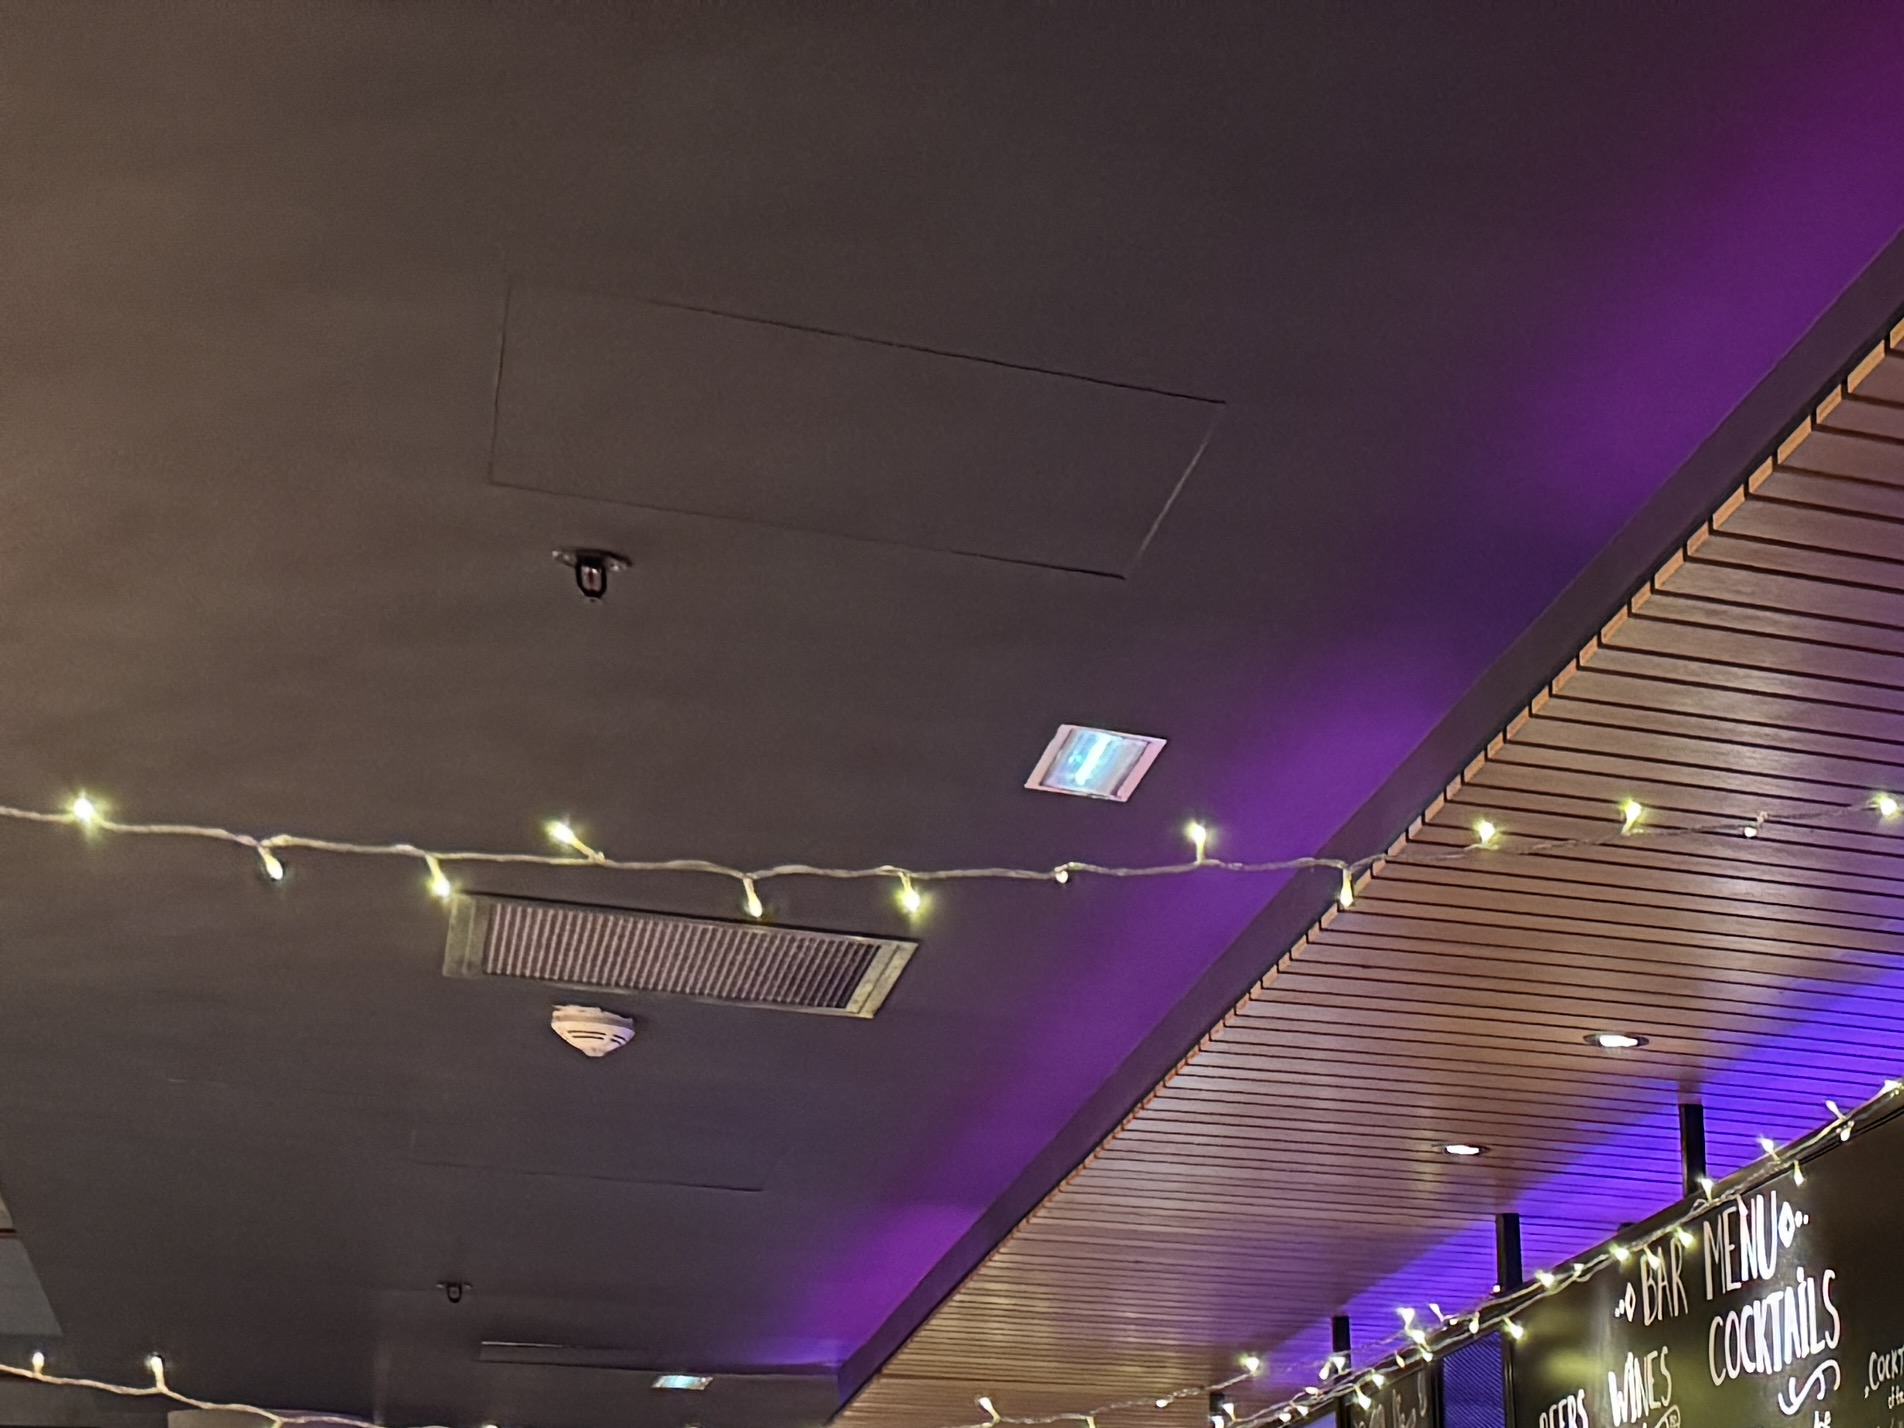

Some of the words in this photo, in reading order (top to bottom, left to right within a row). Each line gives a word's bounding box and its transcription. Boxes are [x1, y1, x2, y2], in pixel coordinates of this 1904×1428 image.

[1640, 1237, 1688, 1327] BAR
[1703, 1190, 1778, 1300] MENU
[1608, 1346, 1672, 1428] WINES
[1709, 1266, 1842, 1387] COCKTAILS
